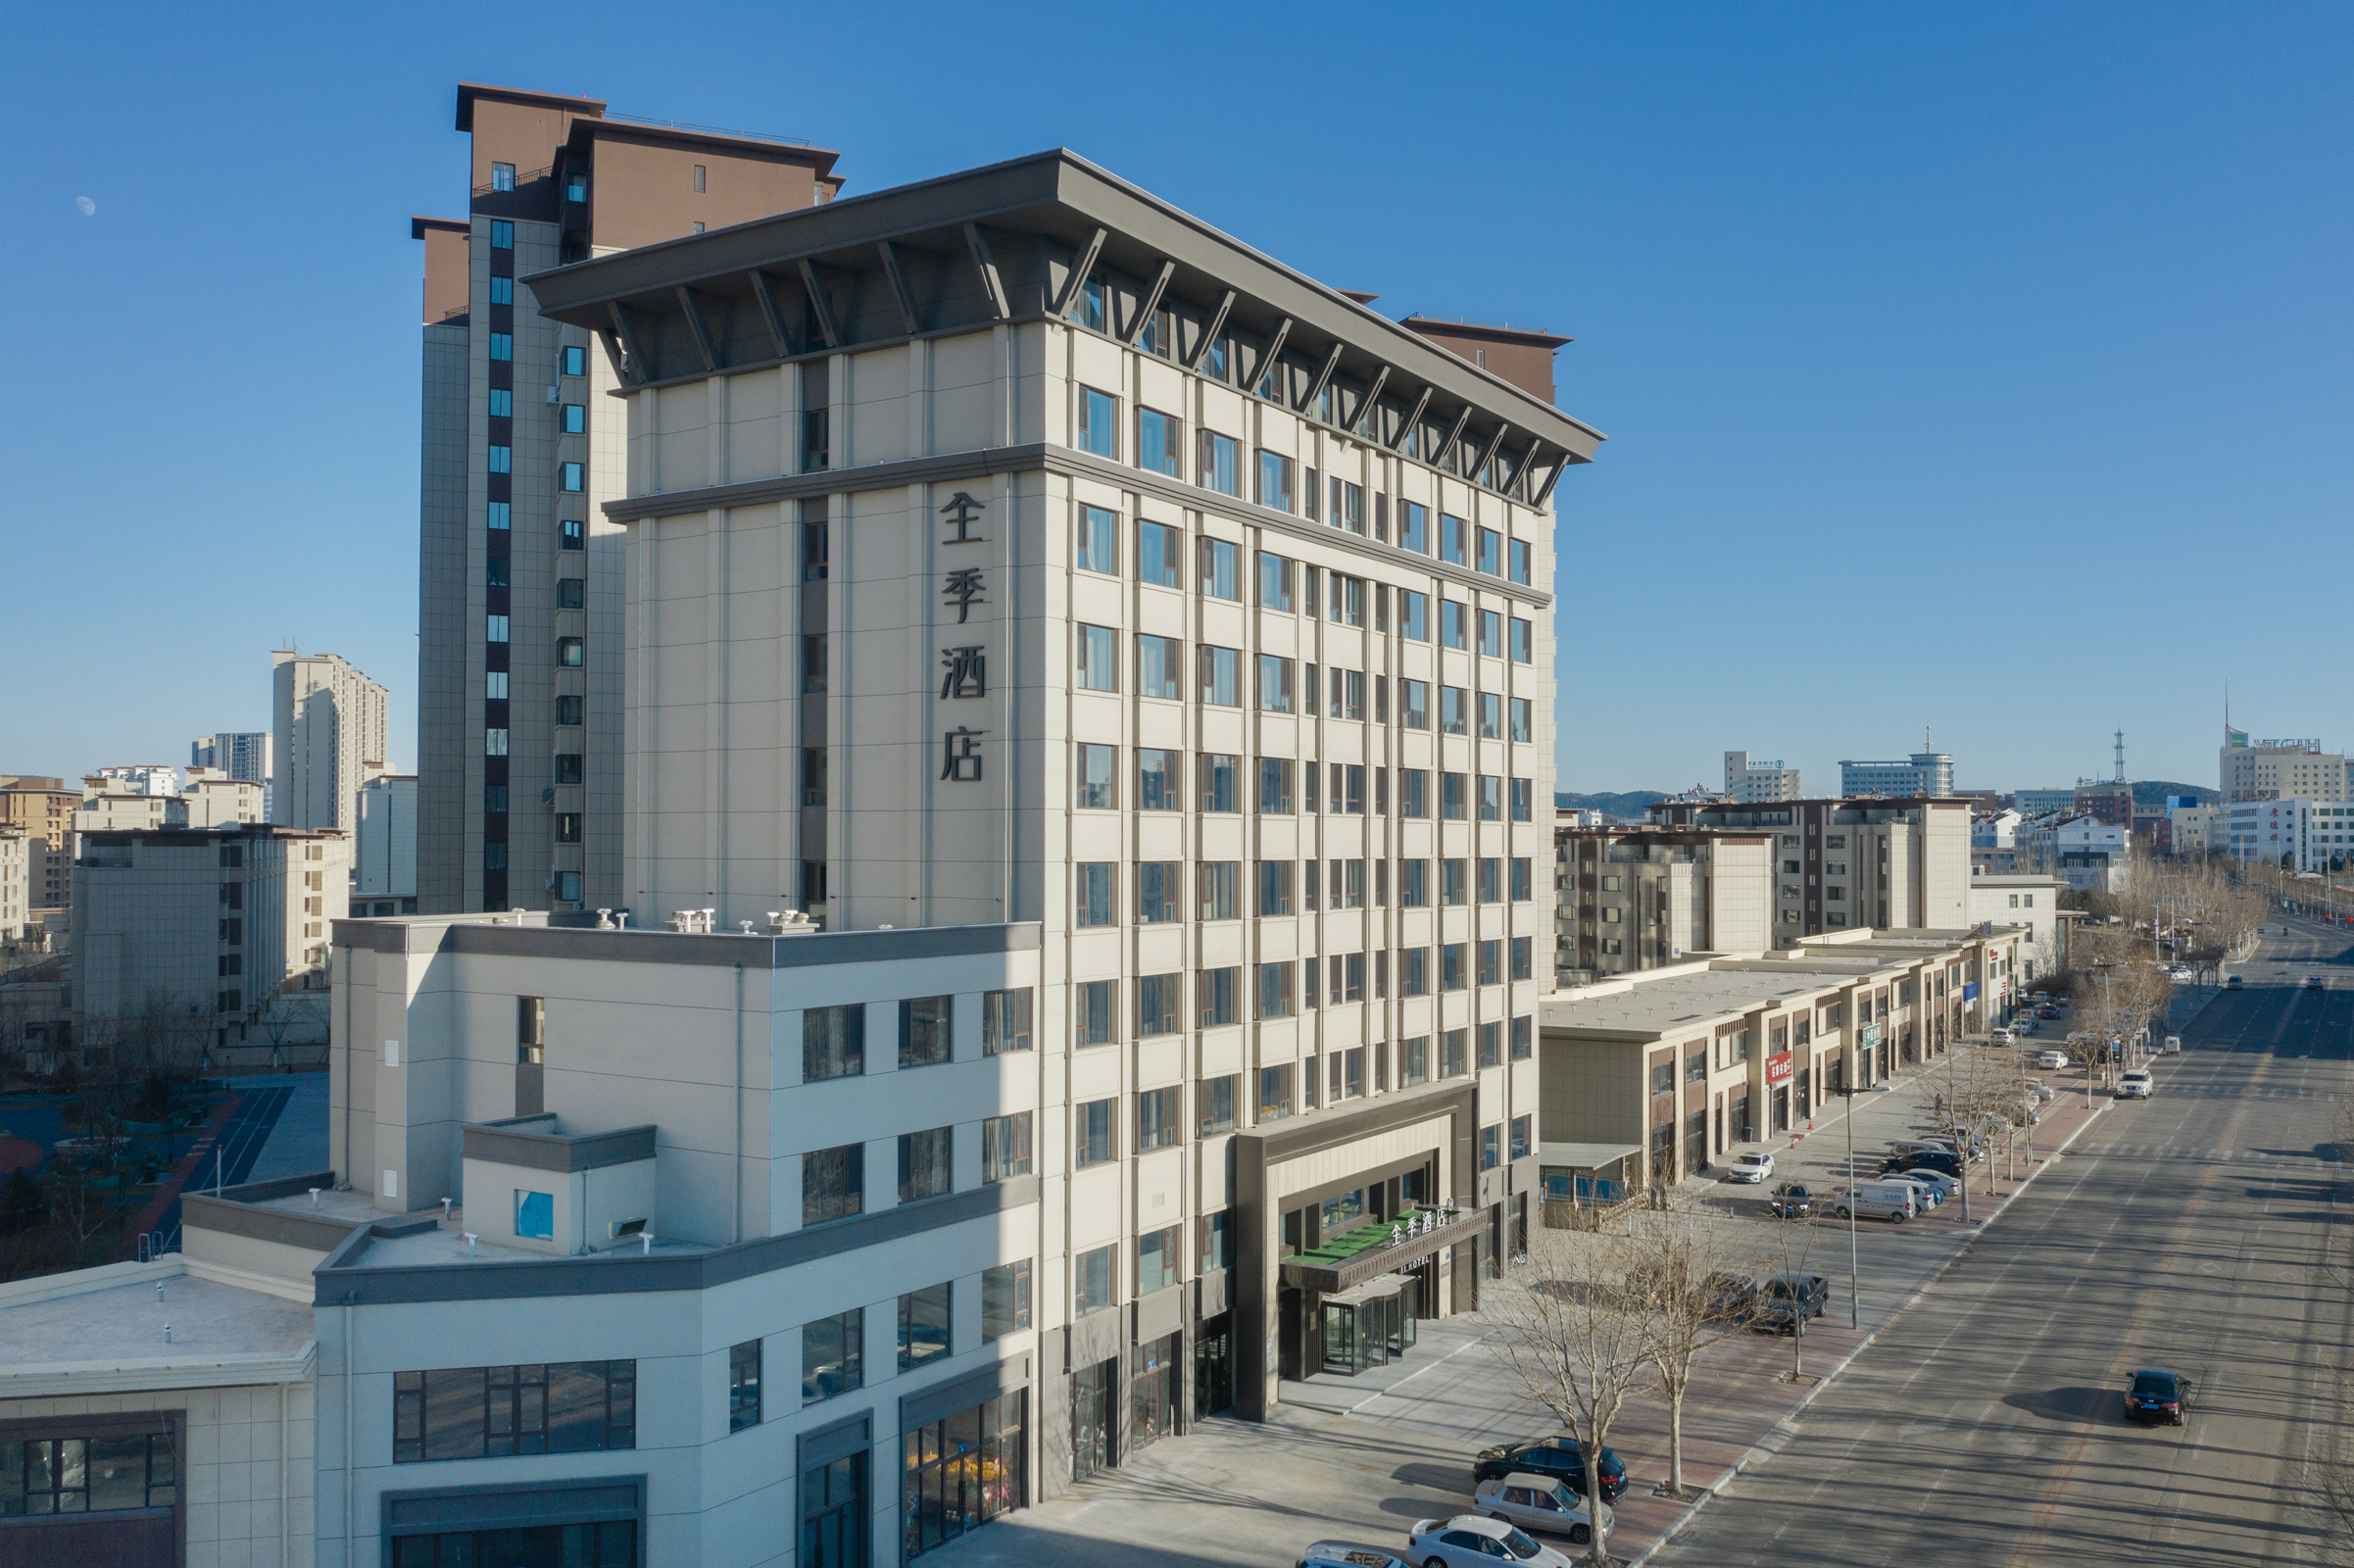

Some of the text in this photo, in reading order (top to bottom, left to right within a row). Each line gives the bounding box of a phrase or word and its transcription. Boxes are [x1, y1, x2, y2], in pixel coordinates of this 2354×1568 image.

[939, 491, 986, 782] 全季酒店
[1392, 1206, 1446, 1247] 全季酒店
[1409, 1256, 1429, 1270] HOTEL
